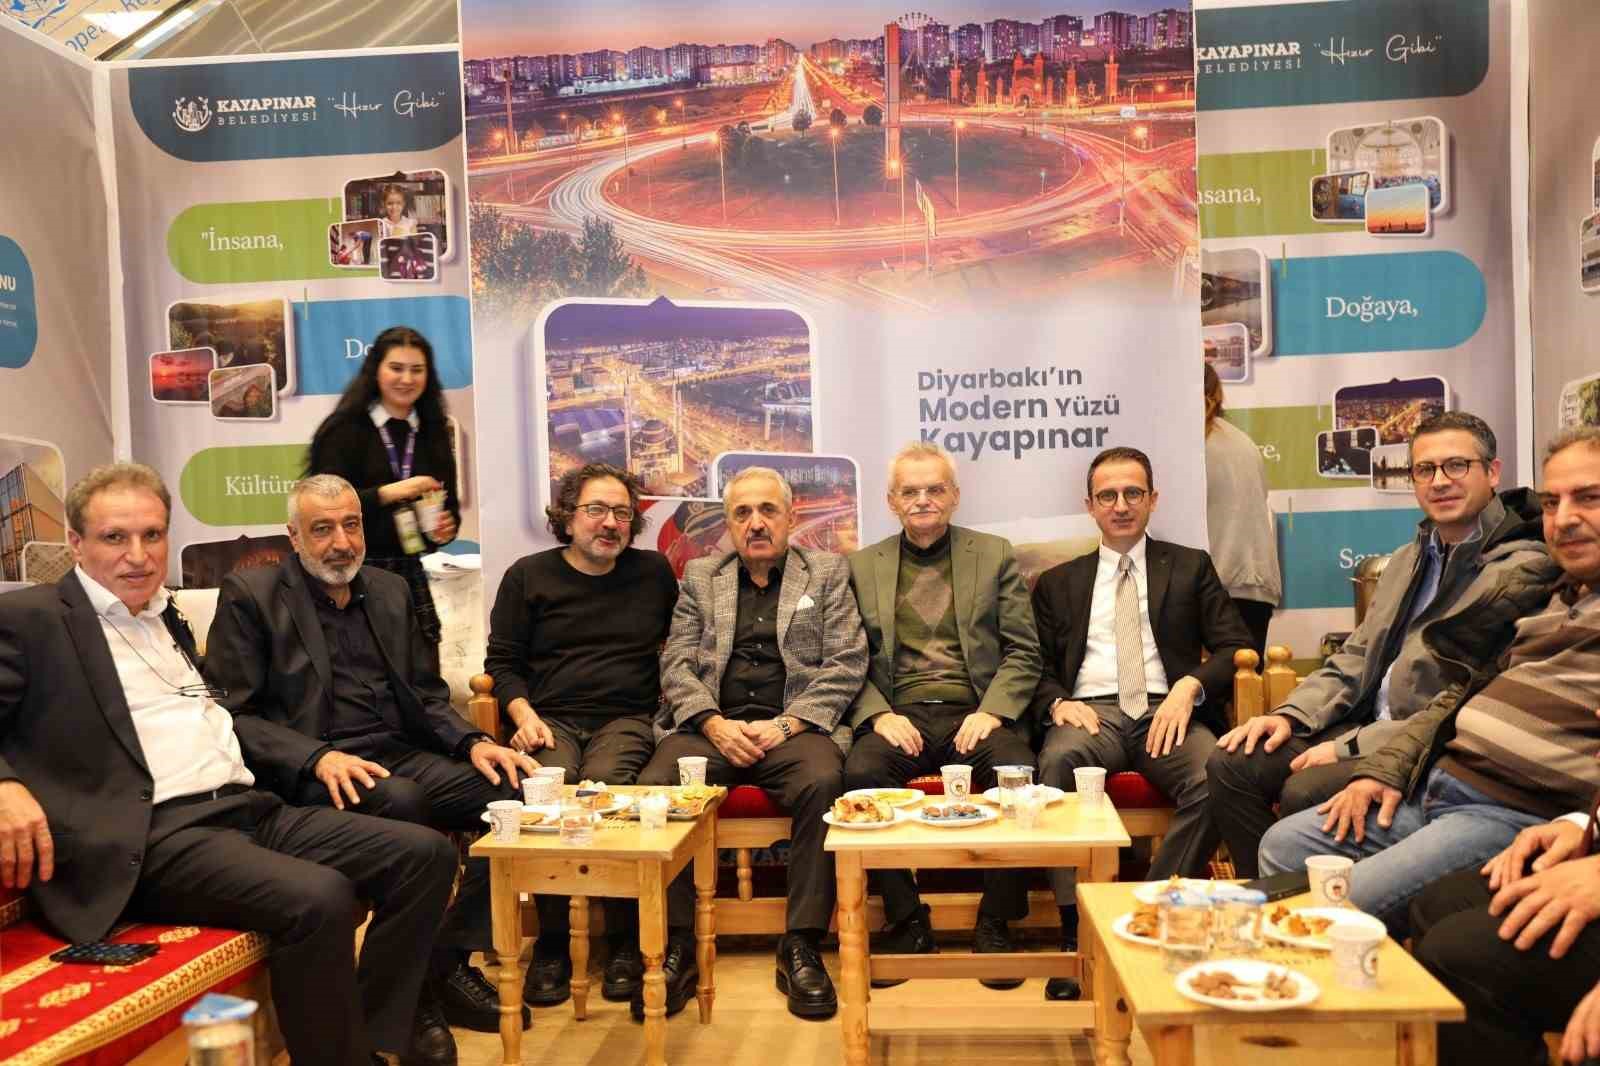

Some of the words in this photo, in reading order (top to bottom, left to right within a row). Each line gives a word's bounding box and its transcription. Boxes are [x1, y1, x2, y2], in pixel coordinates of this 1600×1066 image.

[1197, 58, 1301, 74] ELEDİYESİ
[216, 96, 317, 112] KAYAPINAR
[217, 111, 317, 125] BELEDİYESİ
[1325, 296, 1419, 323] Doğaya,
[919, 395, 1049, 422] Modern
[1055, 394, 1120, 417] Yüzü
[920, 425, 1109, 460] Kayapınar
